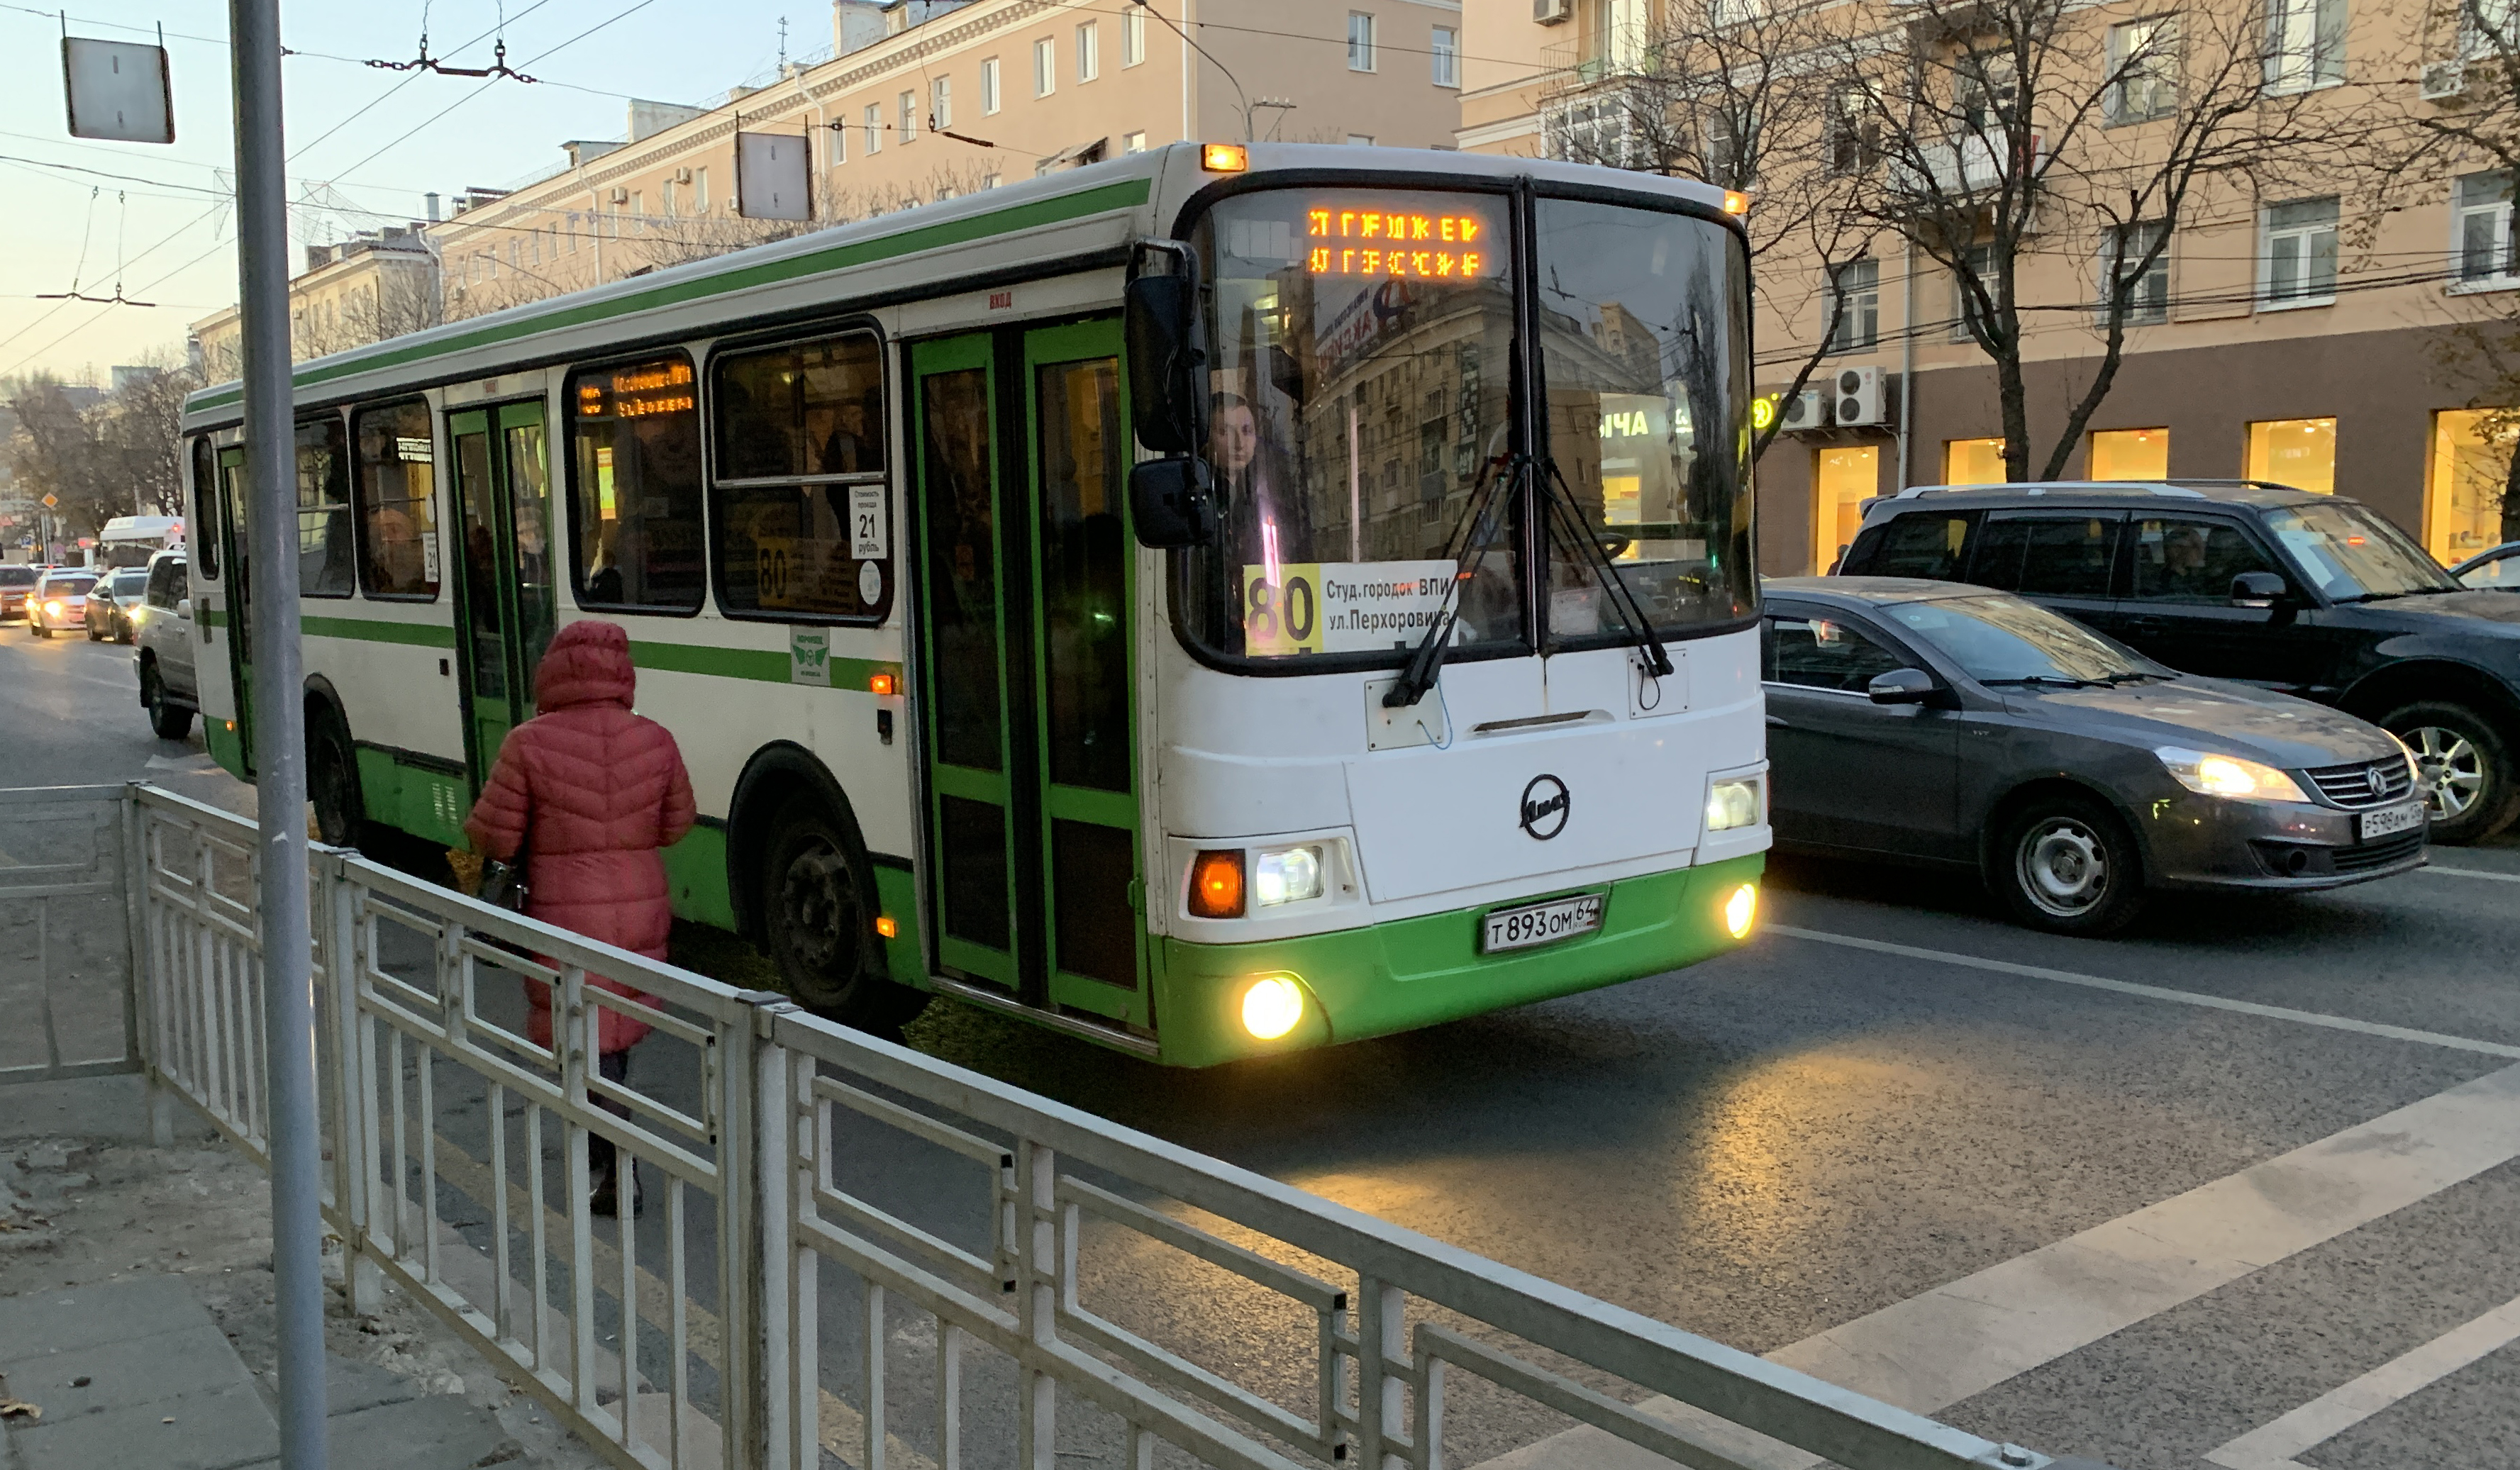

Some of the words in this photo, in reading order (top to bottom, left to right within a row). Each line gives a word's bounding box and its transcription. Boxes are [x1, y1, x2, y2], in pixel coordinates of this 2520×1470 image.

[859, 513, 875, 538] 21
[858, 541, 879, 555] рубль
[760, 547, 787, 599] 80
[1326, 579, 1413, 603] Студ.городок
[1419, 578, 1449, 596] ВПИ
[1248, 576, 1314, 641] 80
[1329, 609, 1450, 634] ул.Перхоровиа
[1576, 899, 1594, 920] 64
